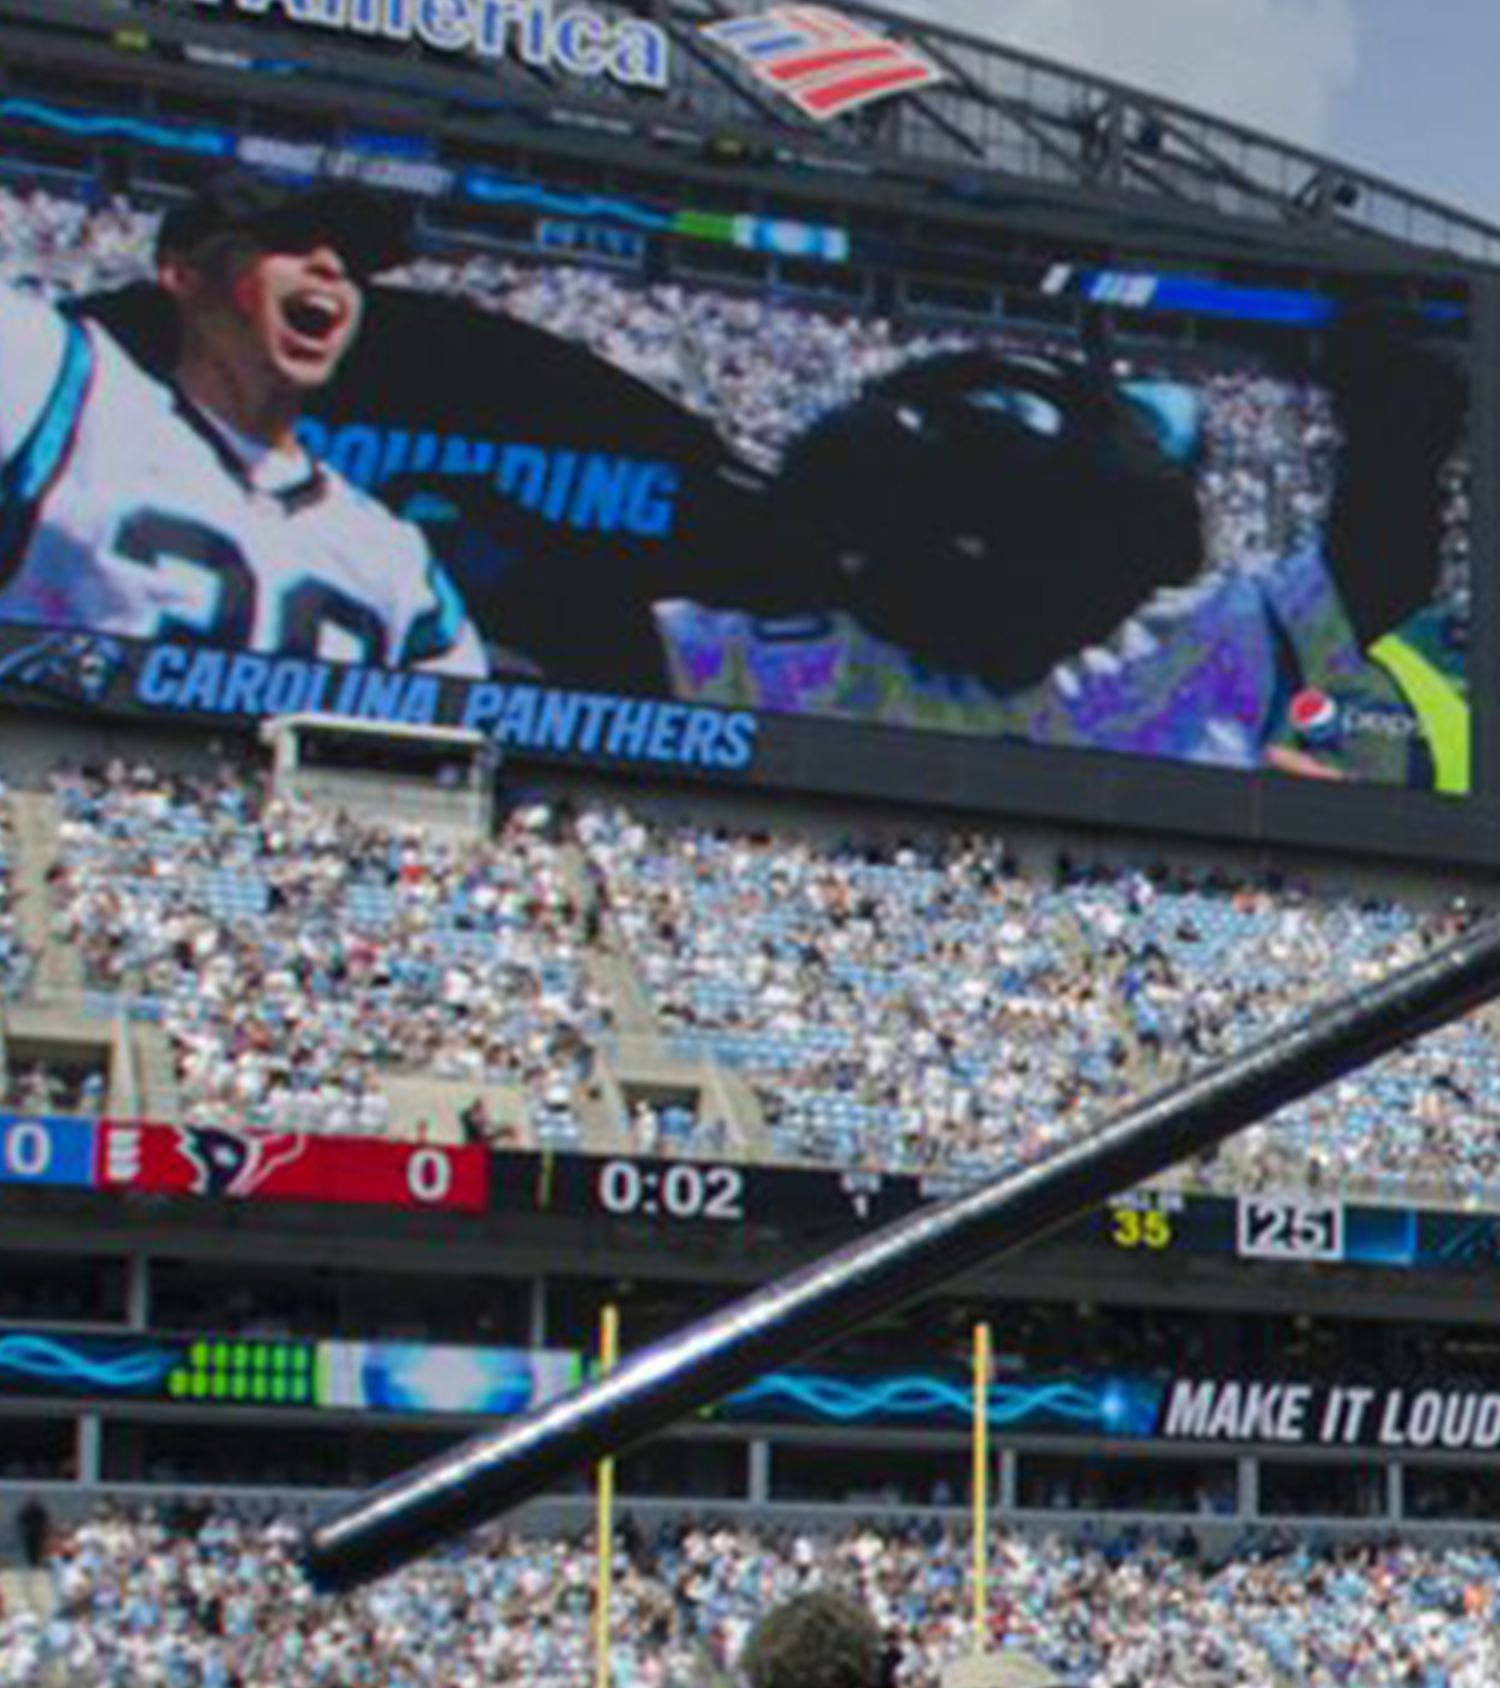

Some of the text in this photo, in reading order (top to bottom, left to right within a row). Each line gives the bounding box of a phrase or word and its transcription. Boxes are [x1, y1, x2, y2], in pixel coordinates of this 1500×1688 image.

[137, 645, 757, 767] CAROLINA PANTHERS
[6, 1123, 51, 1175] 0
[406, 1148, 452, 1201] 0
[600, 1161, 743, 1219] 0:02
[1112, 1209, 1171, 1250] 35
[1248, 1206, 1326, 1250] 25
[1164, 1382, 1304, 1440] MAKE
[1318, 1386, 1370, 1442] IT
